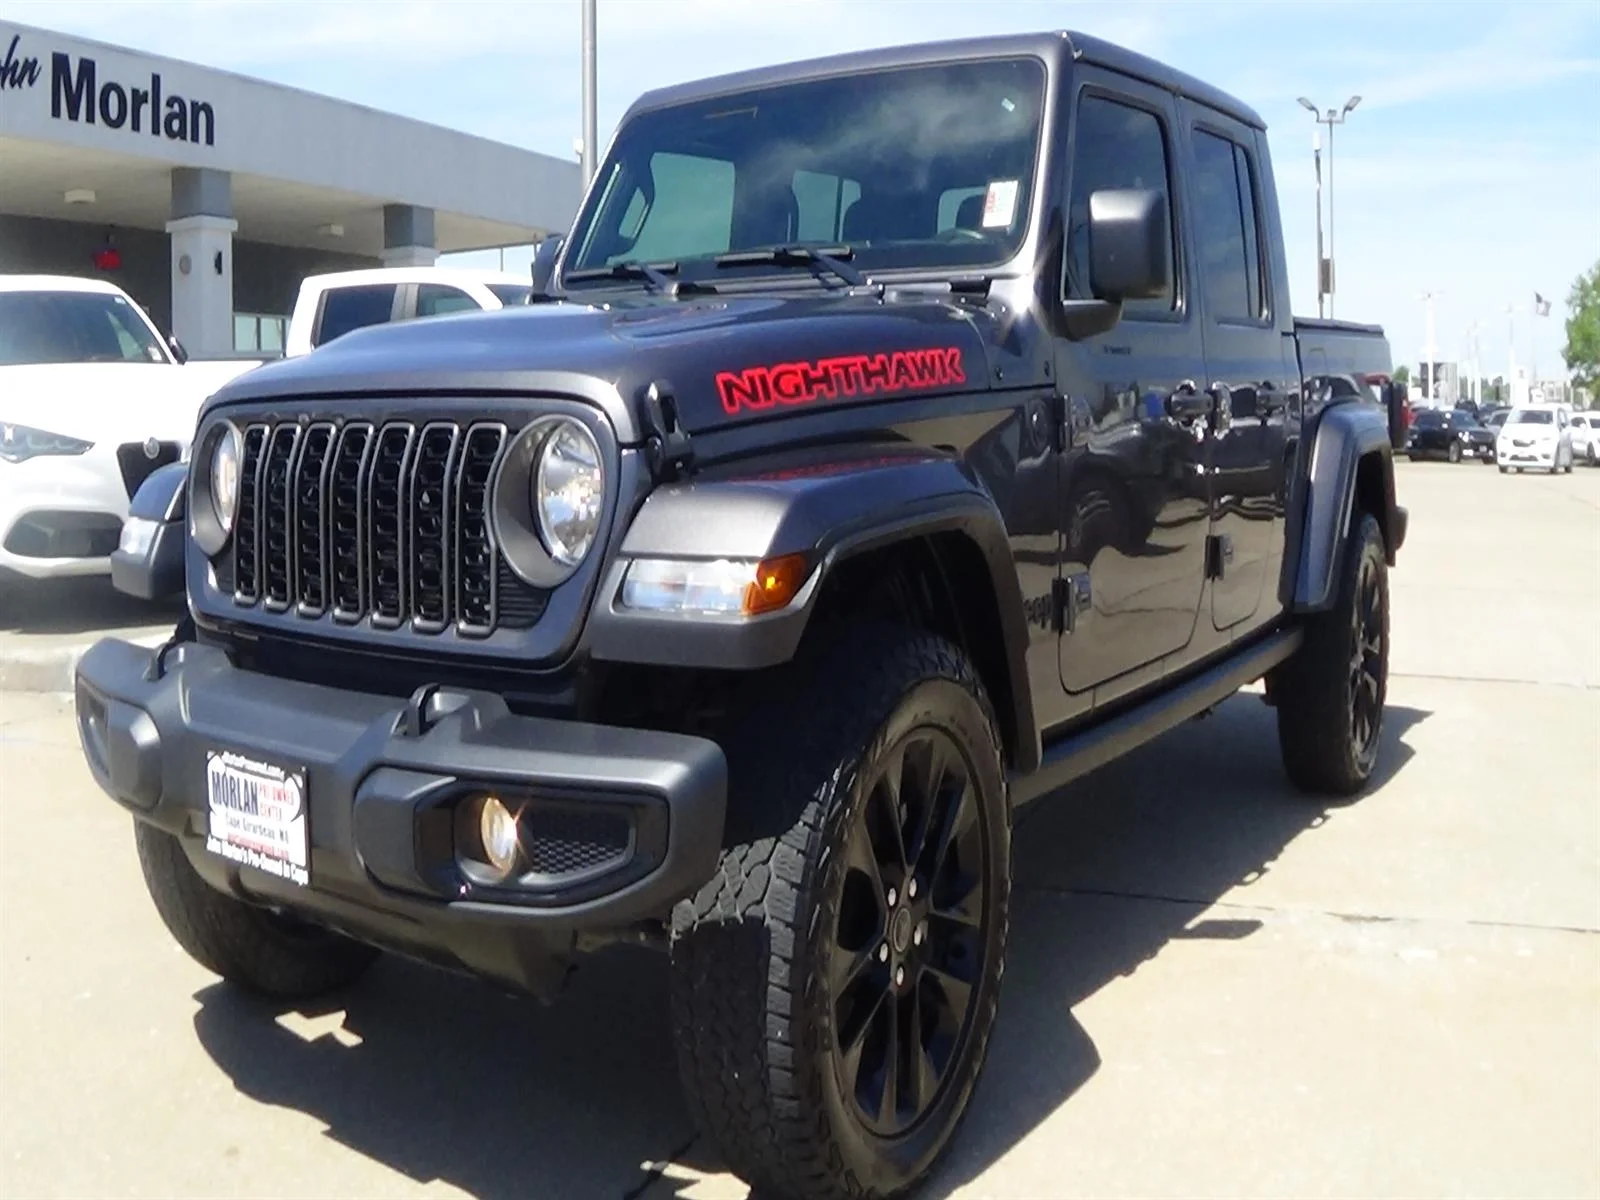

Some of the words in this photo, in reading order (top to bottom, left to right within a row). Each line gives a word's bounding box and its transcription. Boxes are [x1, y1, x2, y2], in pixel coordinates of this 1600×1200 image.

[51, 51, 215, 146] Morlan
[716, 347, 966, 414] NIGHTHAWK
[211, 768, 259, 816] MORLAN
